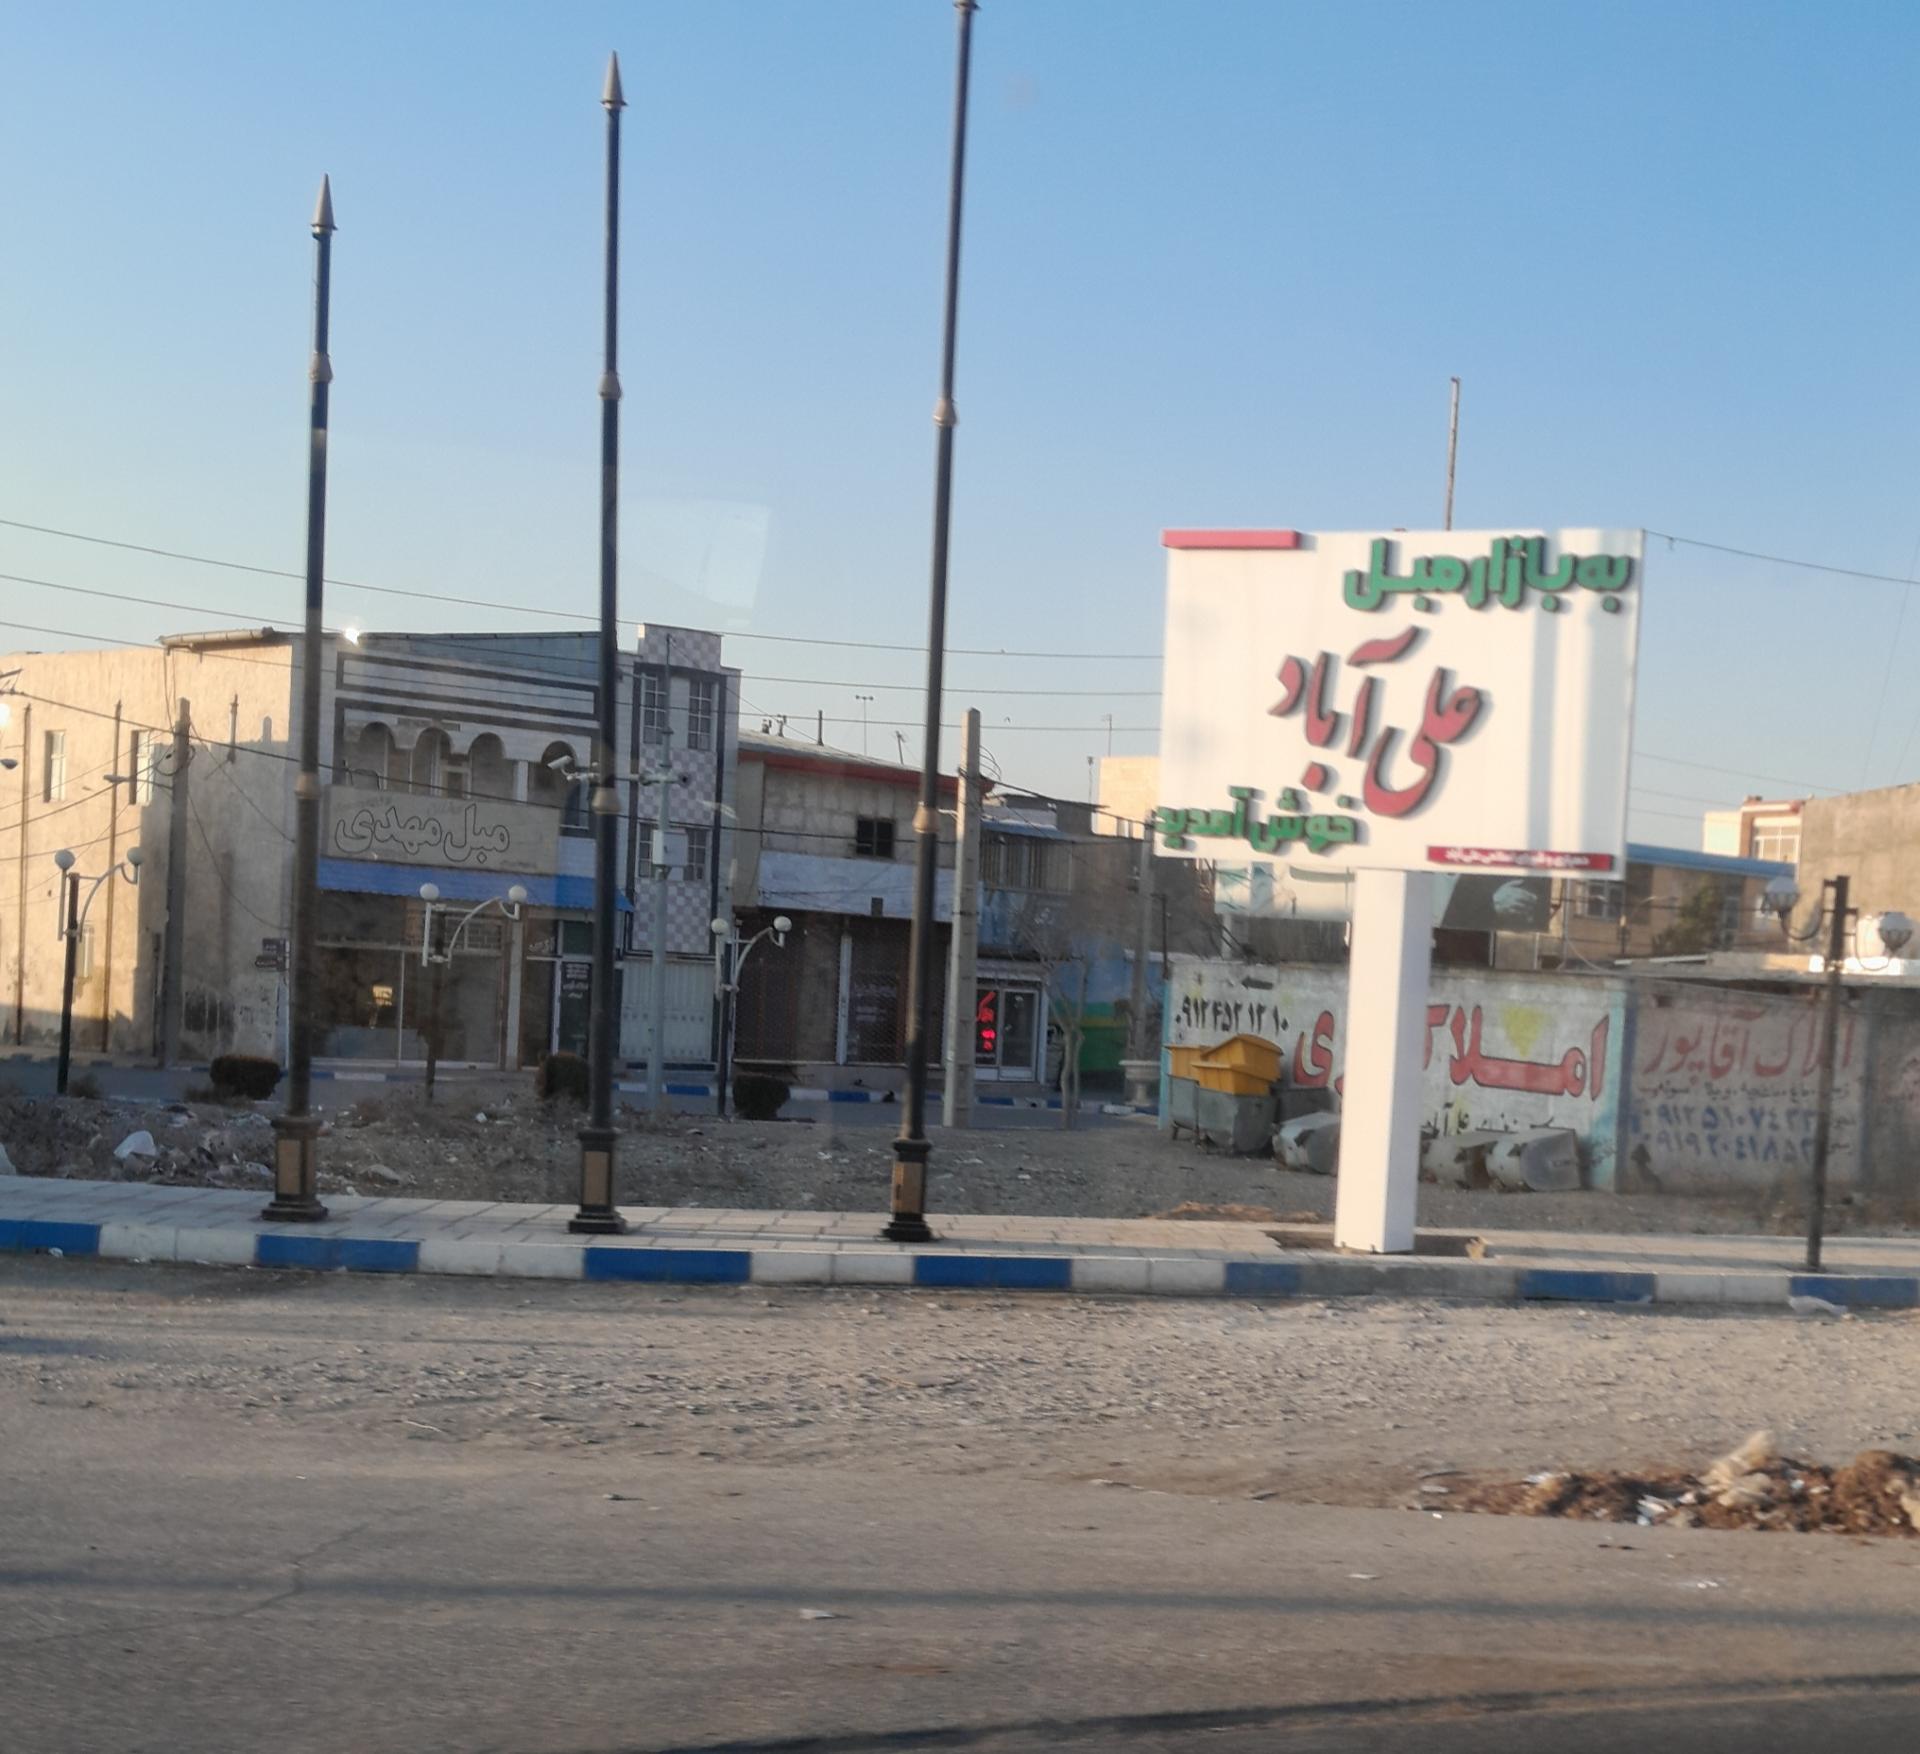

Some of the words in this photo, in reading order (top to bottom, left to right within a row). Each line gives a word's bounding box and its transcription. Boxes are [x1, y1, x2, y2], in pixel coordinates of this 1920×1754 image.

[1344, 538, 1467, 612] مبل
[1467, 536, 1575, 613] بازار
[1578, 552, 1633, 613] به
[1269, 626, 1420, 792] آباد
[1363, 667, 1482, 817] علی
[335, 806, 443, 855] مهدی
[443, 803, 510, 863] مبل
[1154, 786, 1254, 849] آمدید
[1250, 787, 1358, 852] خوش
